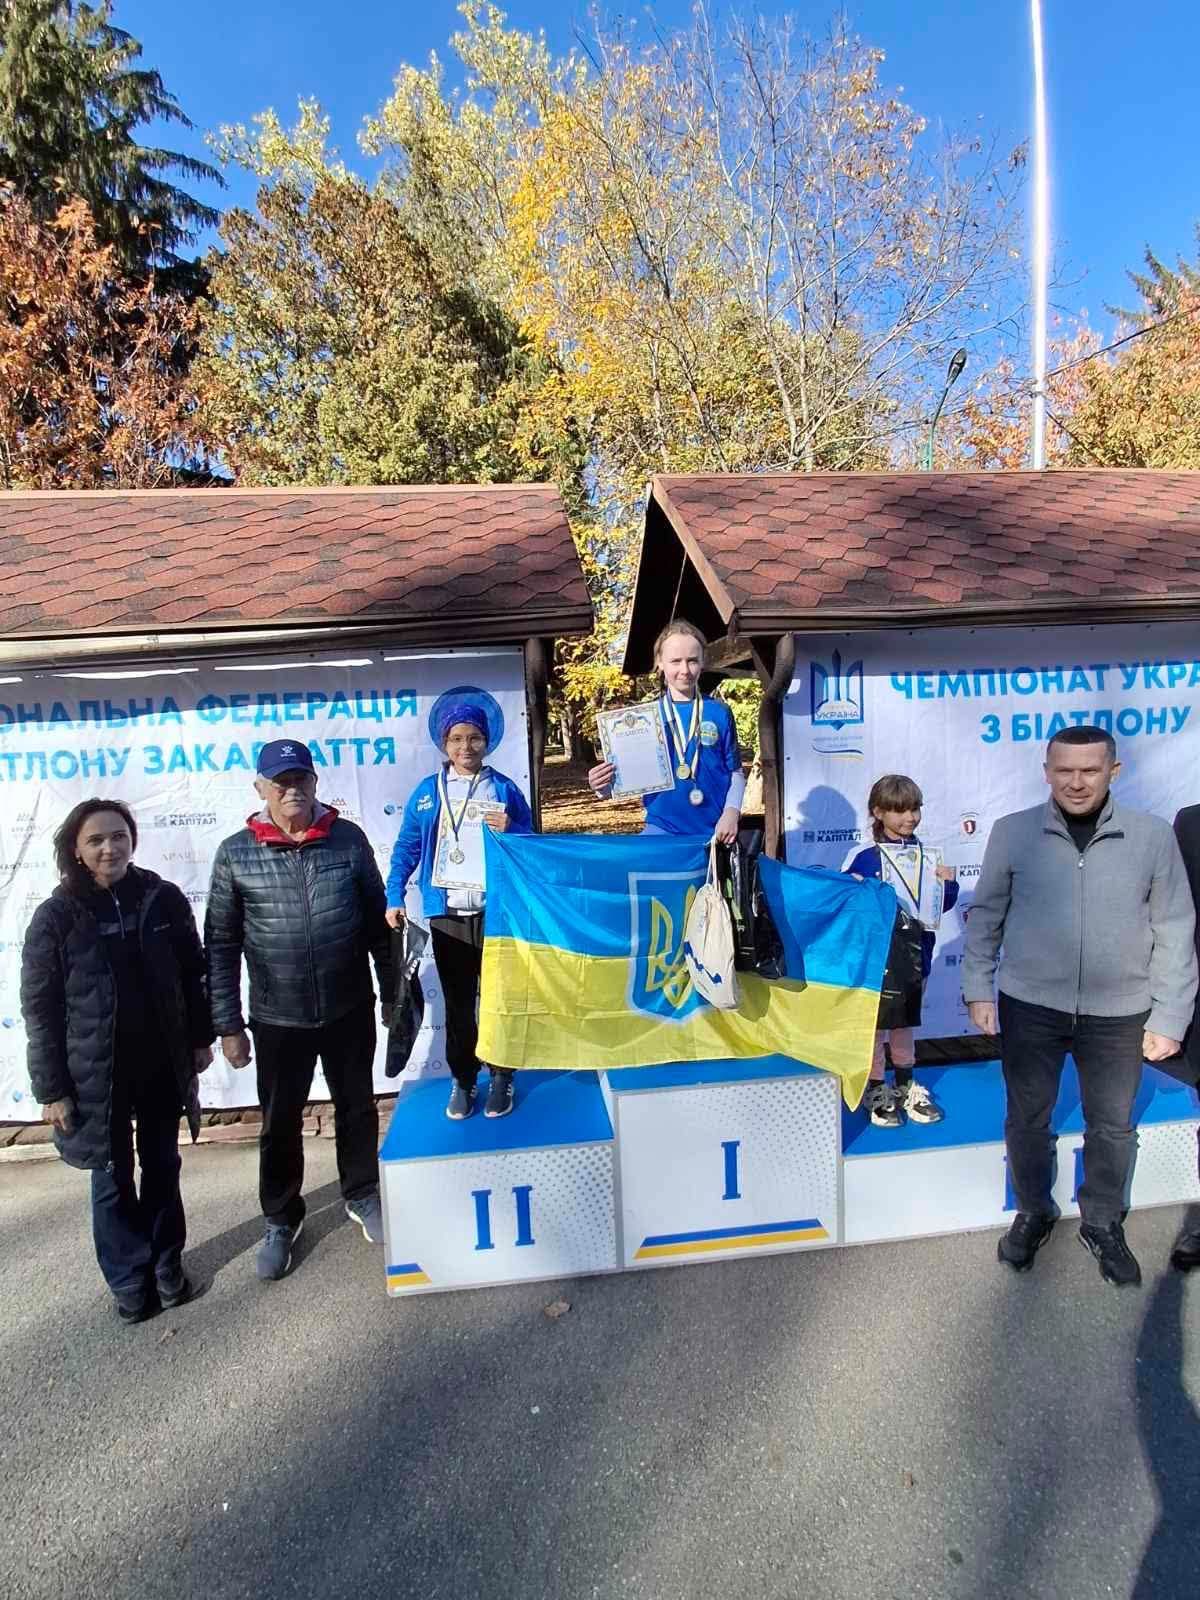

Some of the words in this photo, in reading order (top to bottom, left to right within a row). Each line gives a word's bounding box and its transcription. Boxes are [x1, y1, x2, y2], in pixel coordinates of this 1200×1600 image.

[890, 664, 1109, 699] ЧЕМПІОНАТ
[197, 689, 418, 726] ФЕДЕРАЦІЯ
[980, 714, 1001, 743] З
[0, 747, 132, 781] ТЛОНУ
[143, 736, 396, 775] ЗАКАРАТТЯ
[817, 834, 861, 842] КАПІТАЛ
[721, 1141, 741, 1200] I
[471, 1185, 535, 1250] II
